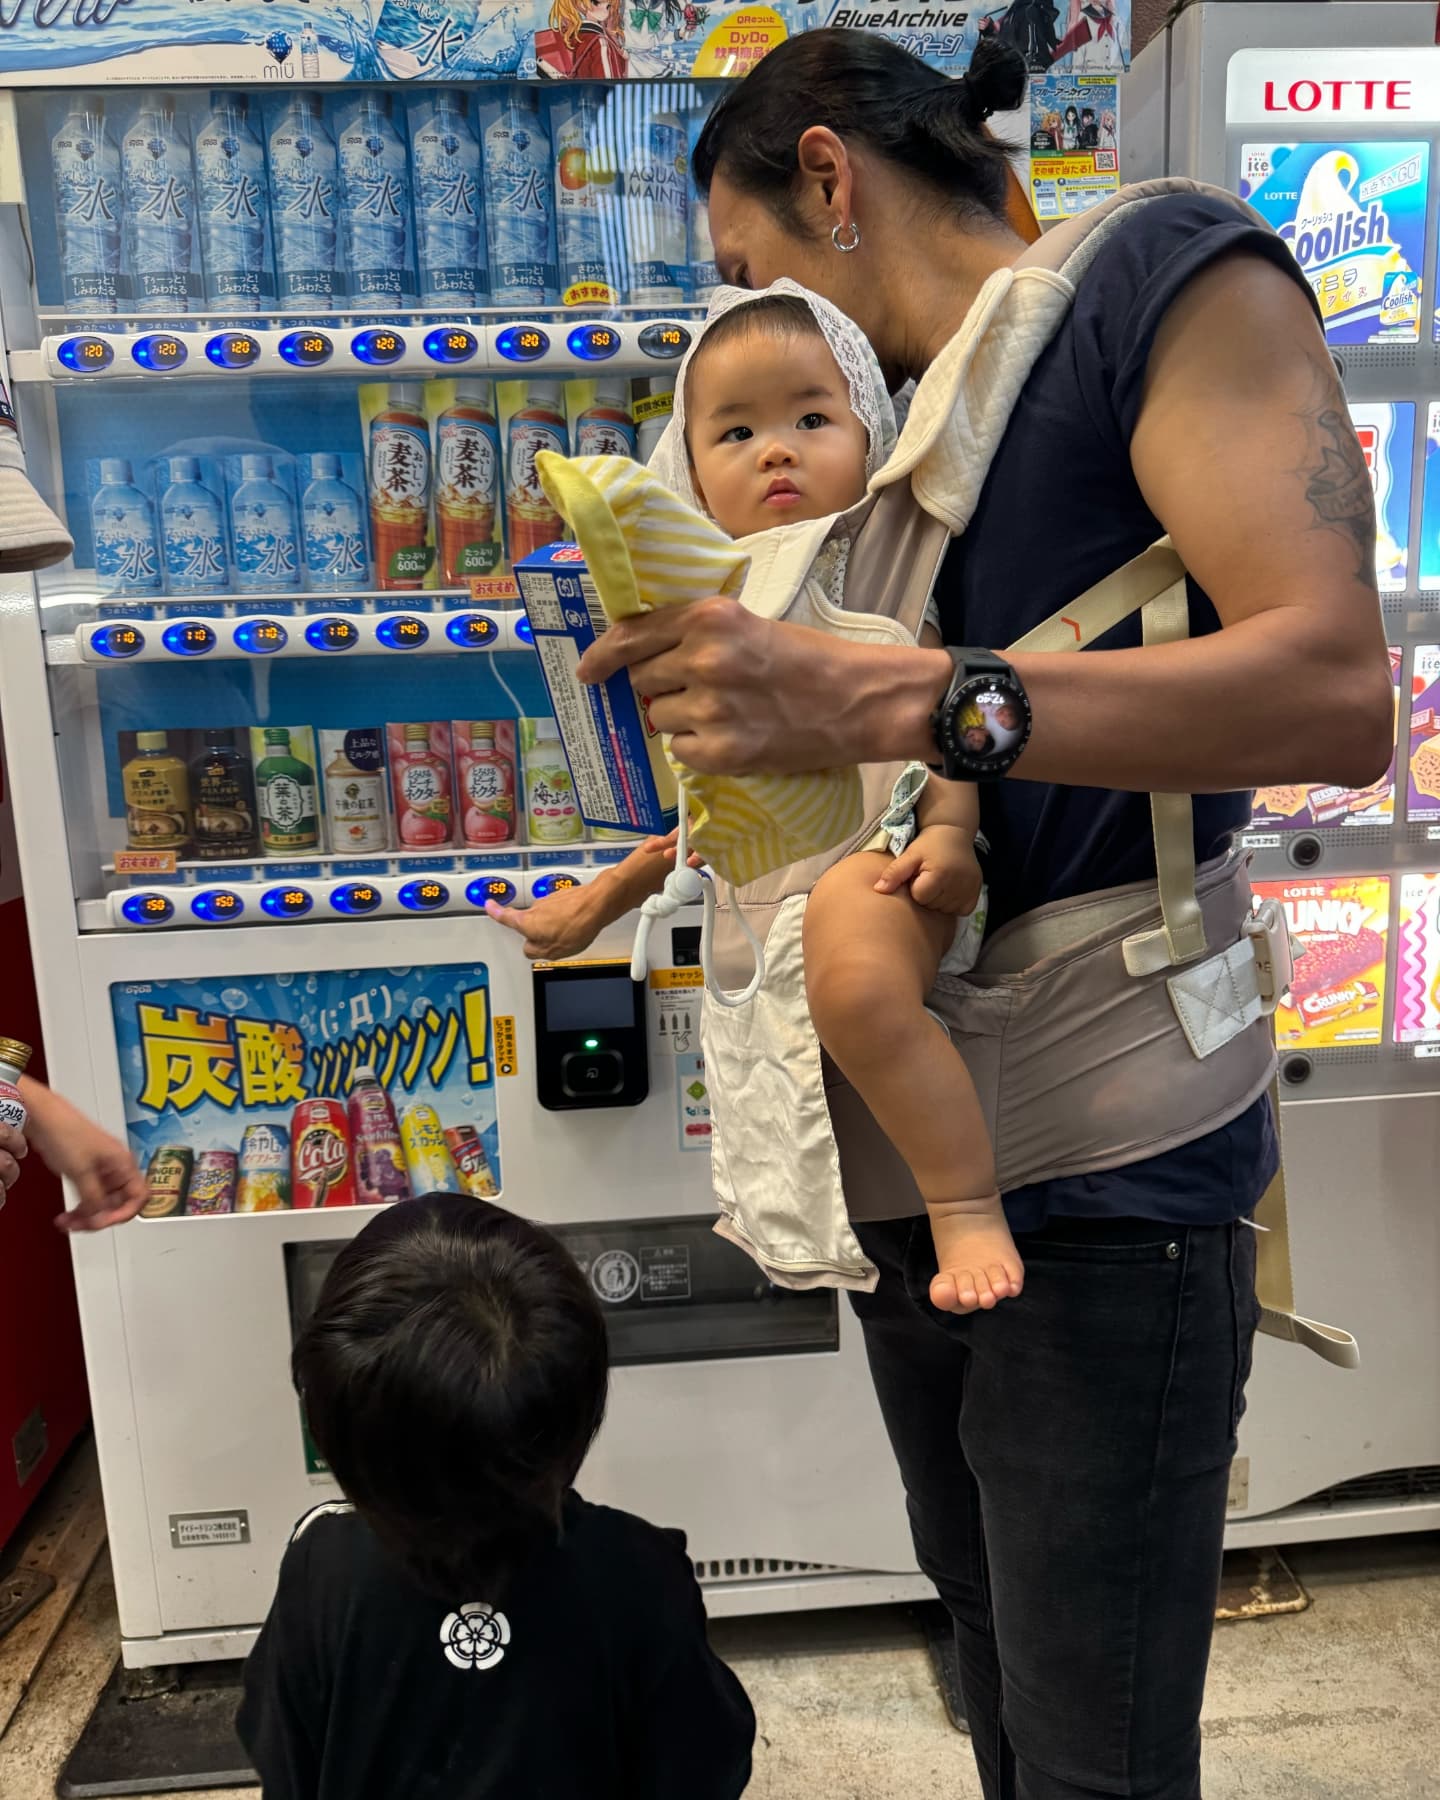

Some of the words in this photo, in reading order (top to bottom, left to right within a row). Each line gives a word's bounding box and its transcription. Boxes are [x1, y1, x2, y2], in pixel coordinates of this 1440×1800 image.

[833, 9, 968, 29] BlueArchive
[404, 18, 463, 68] 水
[730, 31, 769, 45] DyDo
[1264, 80, 1412, 111] LOTTE
[1247, 158, 1269, 172] ice
[286, 175, 332, 219] 水
[357, 174, 401, 218] 水
[432, 172, 476, 217] 水
[503, 169, 545, 212] 水
[1265, 191, 1297, 200] LOTTE
[69, 178, 115, 222] 水
[141, 177, 187, 221] 水
[213, 176, 259, 220] 水
[570, 286, 610, 299] おすすめ
[1384, 291, 1413, 310] Coolish
[376, 337, 395, 349] 120
[448, 335, 467, 348] 120
[520, 334, 539, 347] 120
[591, 333, 610, 345] 150
[662, 331, 680, 344] 170
[85, 345, 103, 357] 120
[158, 343, 177, 355] 120
[231, 341, 250, 353] 120
[304, 339, 323, 351] 120
[384, 441, 412, 493] 麦茶
[452, 438, 480, 489] 麦茶
[185, 539, 224, 578] 水
[257, 538, 296, 577] 水
[325, 536, 364, 576] 水
[398, 552, 425, 561] たっぷり
[464, 549, 493, 558] たっぷり
[117, 541, 156, 580] 水
[475, 582, 515, 596] おすすめ
[400, 623, 419, 635] 140
[470, 621, 489, 633] 140
[408, 778, 433, 788] ピーチ
[473, 776, 498, 786] ピーチ
[405, 788, 440, 800] ネクター
[469, 785, 505, 798] ネクター
[120, 856, 161, 869] おすすめ
[489, 883, 507, 894] 150
[555, 879, 573, 890] 150
[285, 892, 304, 904] 150
[354, 889, 372, 901] 140
[422, 886, 440, 897] 150
[1283, 887, 1325, 898] LOTTE
[146, 899, 165, 911] 150
[215, 896, 234, 907] 150
[1284, 899, 1375, 936] UNKY
[671, 971, 703, 979] キャッシ
[1303, 991, 1356, 1013] CRUNKY
[298, 1133, 347, 1172] Cola
[151, 1175, 171, 1185] ALE
